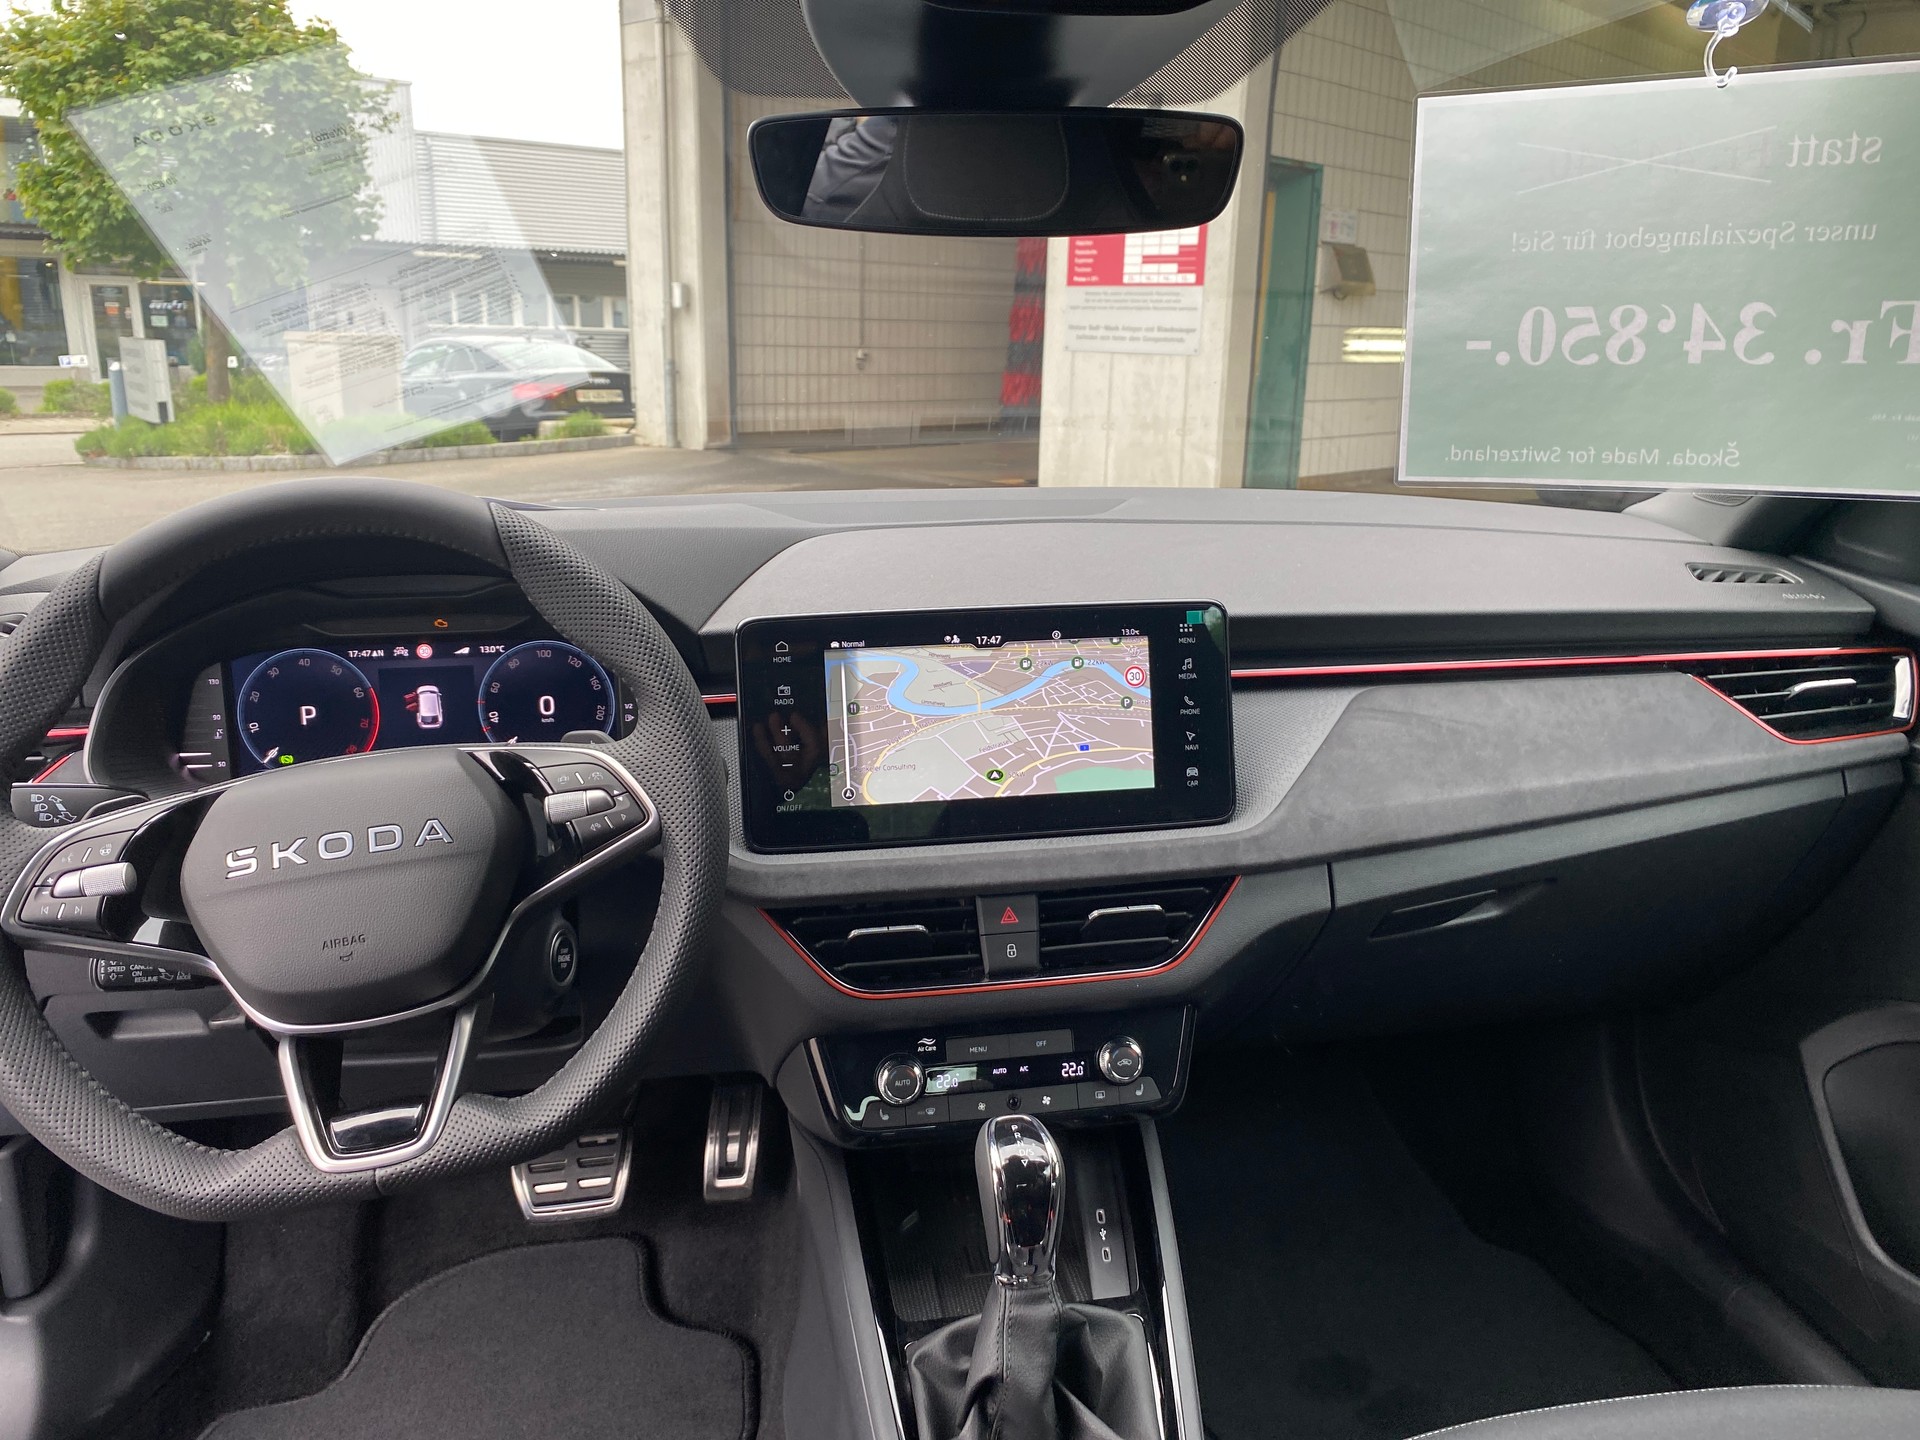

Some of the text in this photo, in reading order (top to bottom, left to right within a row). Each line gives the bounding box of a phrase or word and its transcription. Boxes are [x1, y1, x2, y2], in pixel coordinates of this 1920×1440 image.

[841, 640, 865, 648] Normal
[976, 634, 1002, 646] 17:47
[348, 649, 372, 658] 17:47
[536, 649, 552, 658] 100
[298, 658, 311, 667] 40
[507, 658, 520, 670] 80
[567, 655, 582, 669] 120
[267, 667, 280, 679] 30
[330, 664, 344, 676] 50
[1129, 672, 1141, 681] 30
[490, 681, 501, 694] 60
[589, 675, 602, 692] 160
[249, 690, 260, 703] 20
[353, 686, 365, 699] 60
[538, 695, 556, 716] 0
[299, 705, 317, 726] P
[488, 711, 500, 723] 40
[596, 704, 606, 721] 200
[248, 722, 260, 733] 10
[882, 763, 916, 773] Consulting
[776, 804, 803, 812] ON/OFF
[322, 933, 366, 951] AIRBAG
[895, 1079, 911, 1087] AUTO
